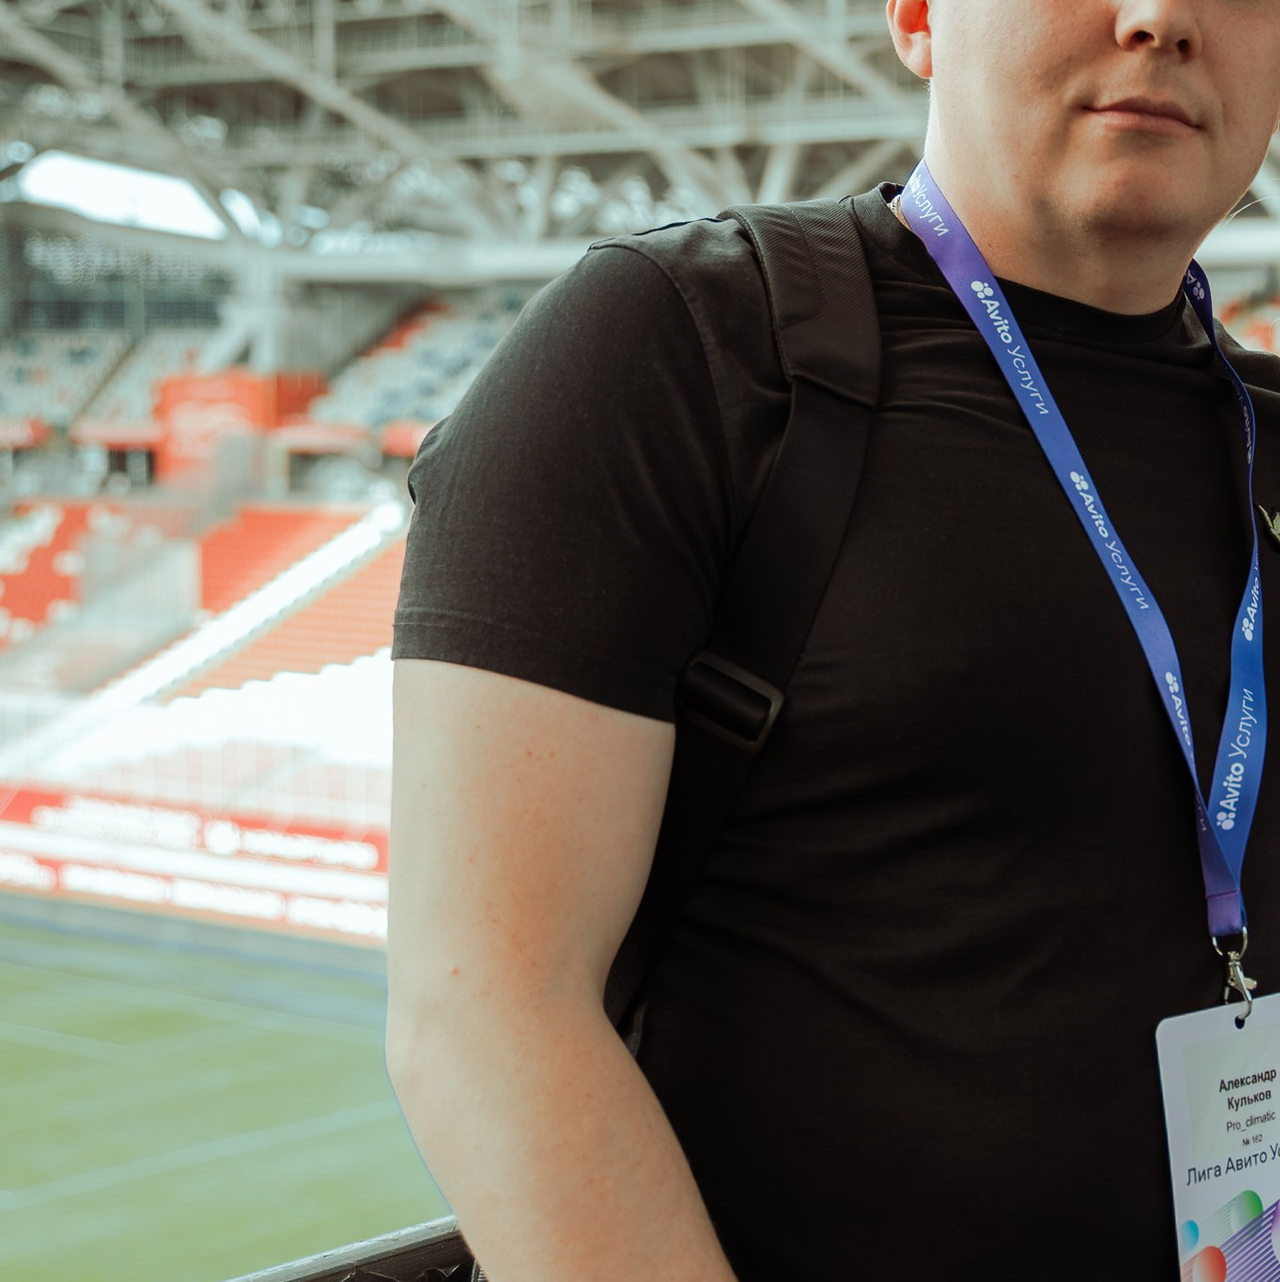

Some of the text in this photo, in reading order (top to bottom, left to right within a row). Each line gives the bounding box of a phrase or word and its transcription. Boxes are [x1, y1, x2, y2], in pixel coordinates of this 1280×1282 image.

[913, 184, 949, 237] Услуги
[982, 298, 1049, 415] Avito Услуги
[1080, 491, 1150, 611] Avito Услуги
[1220, 688, 1258, 811] Avito Услуги
[1219, 1069, 1277, 1093] Александр
[1227, 1090, 1271, 1112] Кульков
[1186, 1164, 1222, 1186] Лига
[1225, 1151, 1268, 1175] Авито
